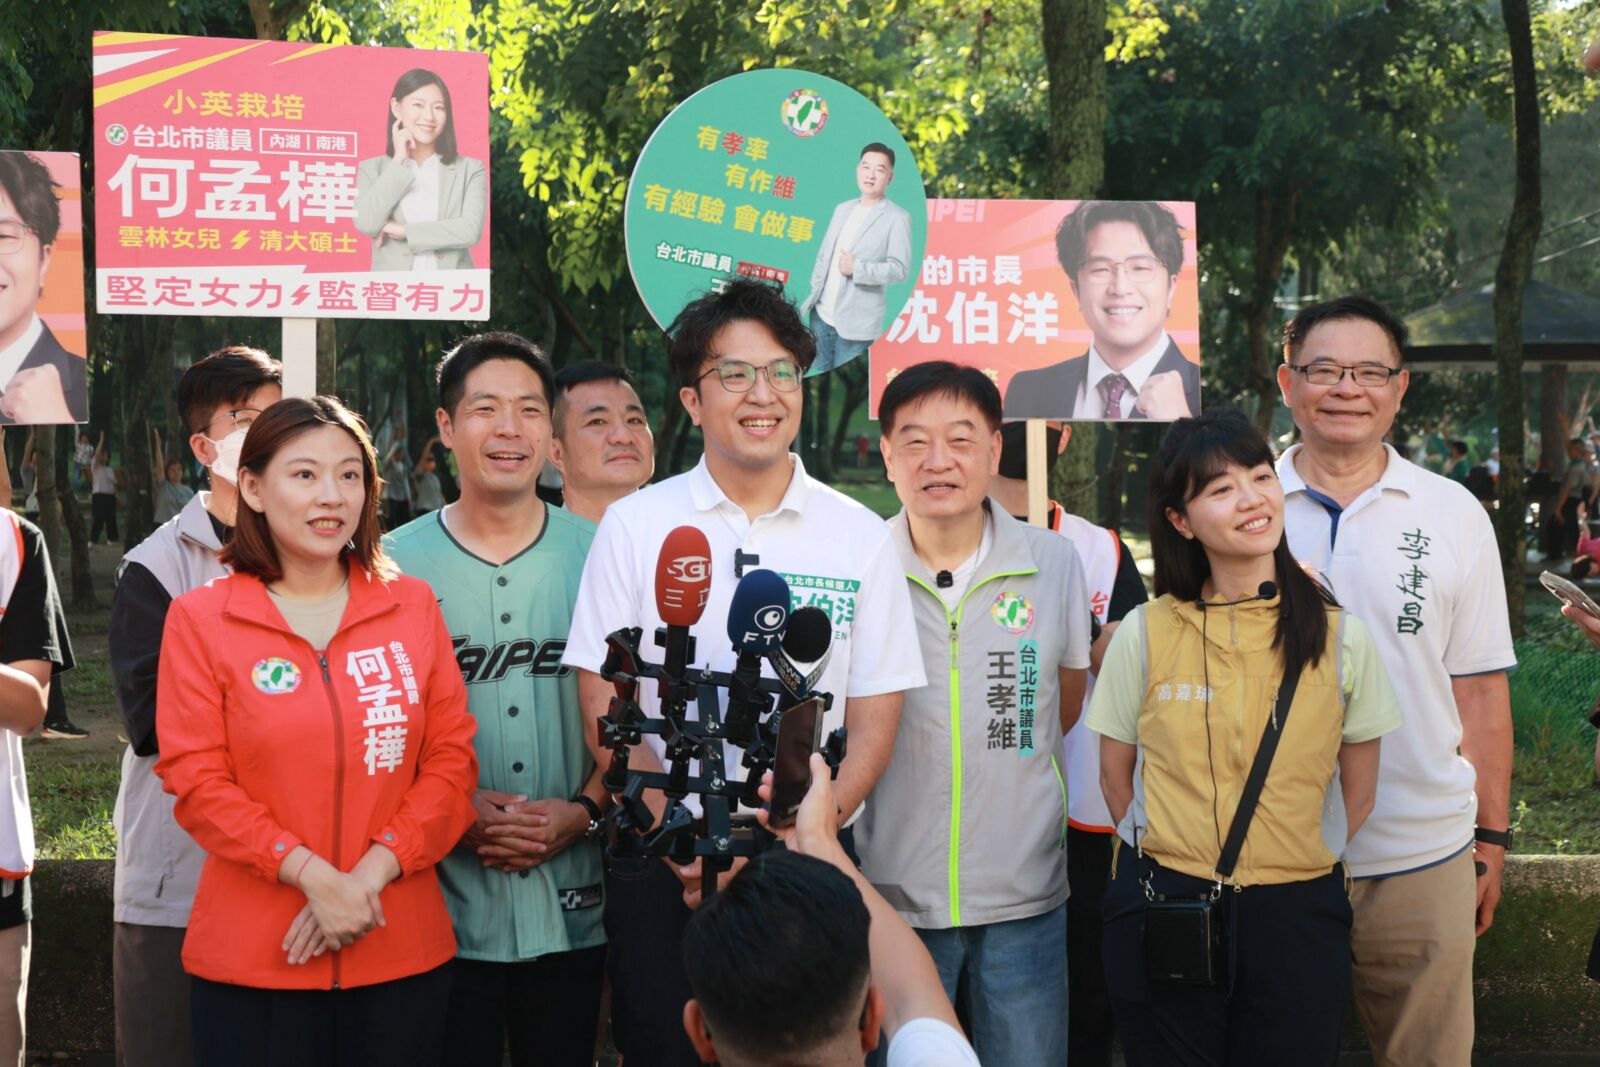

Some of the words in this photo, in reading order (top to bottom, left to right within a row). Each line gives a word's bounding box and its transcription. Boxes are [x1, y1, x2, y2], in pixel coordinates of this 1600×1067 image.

[163, 88, 305, 120] 小英栽培
[133, 124, 253, 151] 台北市議員
[696, 125, 769, 161] 有孝率
[107, 153, 359, 224] 何孟樺
[724, 163, 796, 199] 有作維
[643, 183, 726, 225] 有經驗
[733, 203, 815, 244] 會做事
[118, 225, 221, 249] 雲林女兒
[259, 230, 358, 253] 清大碩士
[656, 242, 732, 273] 台北市議員
[923, 255, 1023, 285] 的市長
[105, 276, 283, 307] 堅定女力
[317, 281, 484, 313] 監督有力
[886, 290, 1058, 344] 沈伯洋
[1397, 528, 1431, 635] 李建昌
[743, 630, 786, 645] FTV
[453, 636, 572, 684] AIPE
[345, 646, 408, 776] 何孟樺
[987, 651, 1017, 750] 王孝維
[1019, 644, 1037, 750] 台北市議員
